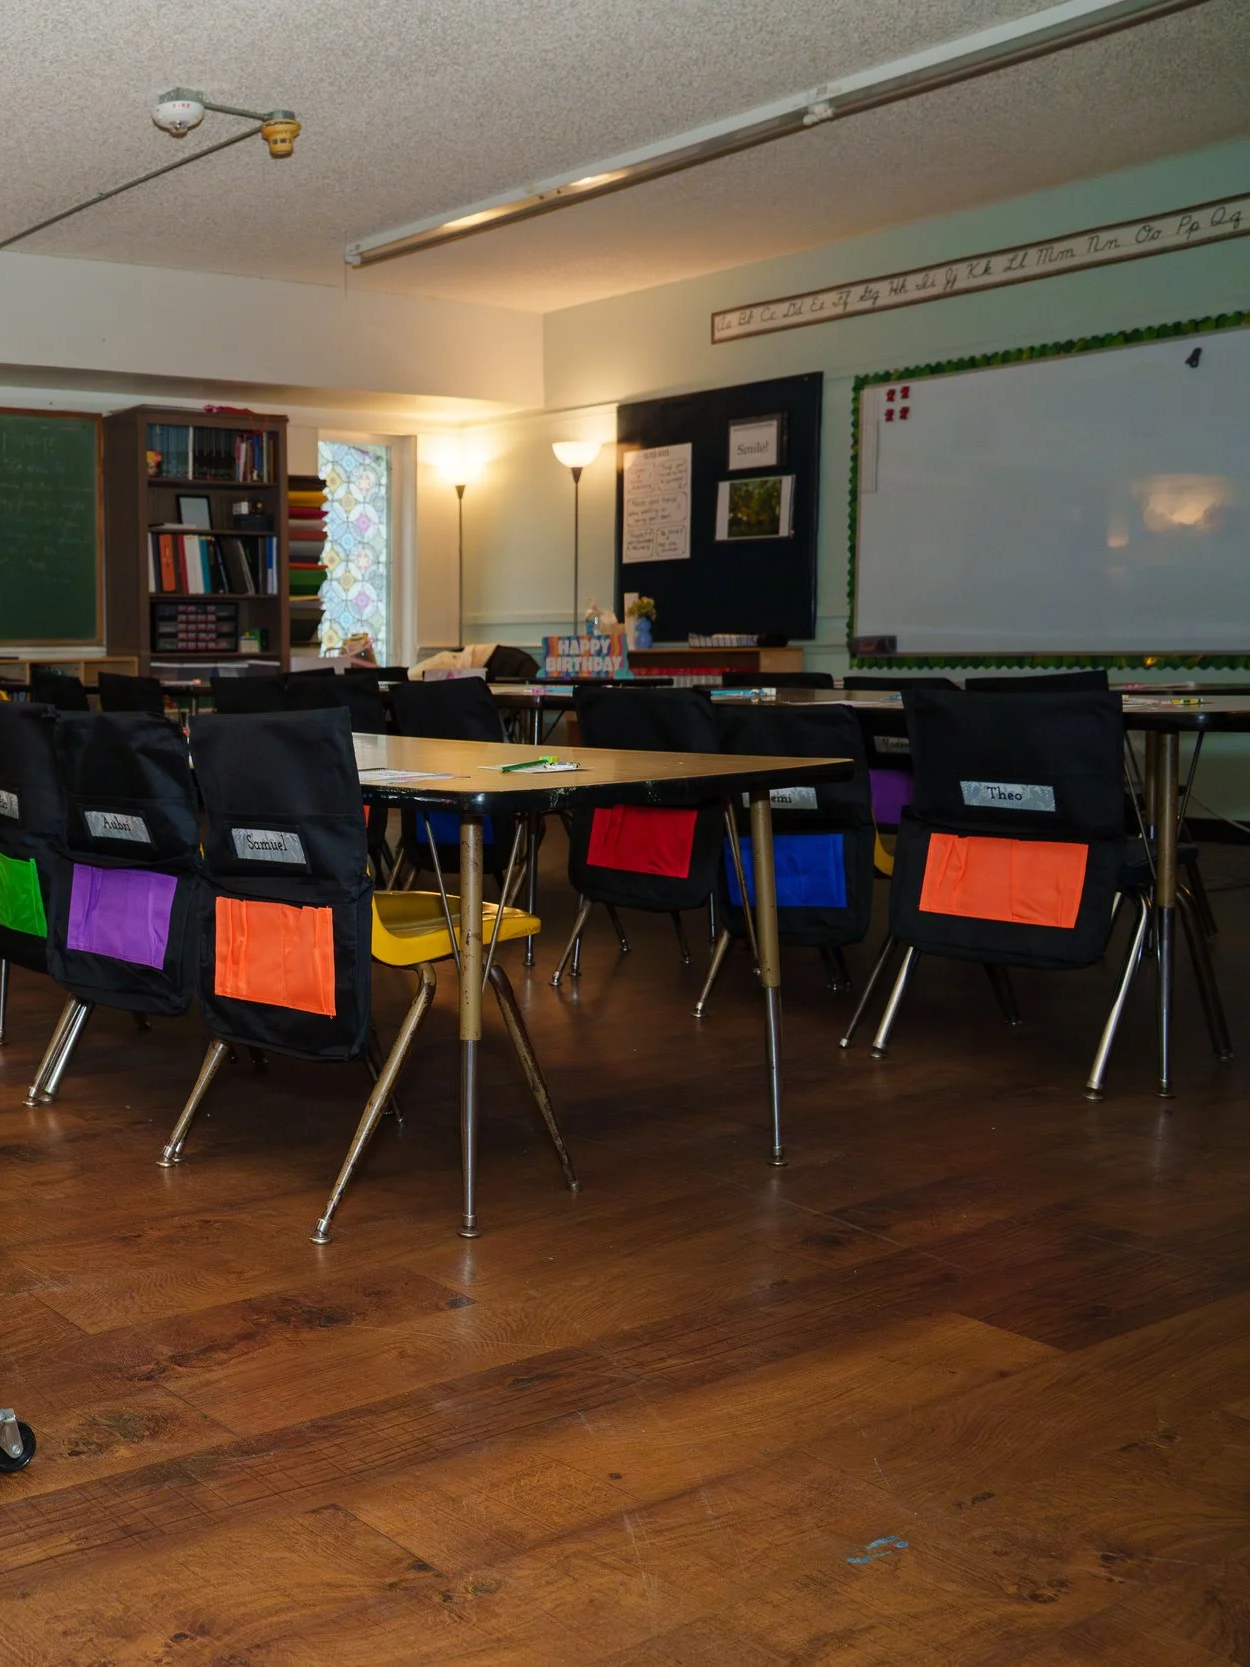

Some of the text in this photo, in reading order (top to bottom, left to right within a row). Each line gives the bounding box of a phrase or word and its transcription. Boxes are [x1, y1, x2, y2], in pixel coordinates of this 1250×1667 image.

[760, 306, 776, 322] Cc
[888, 279, 908, 296] Hh
[966, 260, 994, 279] Kk
[1002, 251, 1027, 273] Ll
[1036, 246, 1075, 266] Mm
[1087, 235, 1120, 254] Nn
[1135, 223, 1162, 244] Oo
[1176, 215, 1201, 241] Pp
[1210, 206, 1242, 229] Qq
[736, 440, 769, 456] Smile!
[558, 639, 611, 655] HAPPY
[545, 656, 623, 672] BIRTHDAY
[771, 793, 793, 804] emi
[987, 786, 1023, 801] Theo
[103, 816, 132, 832] Aubri
[246, 834, 288, 852] Samuel
